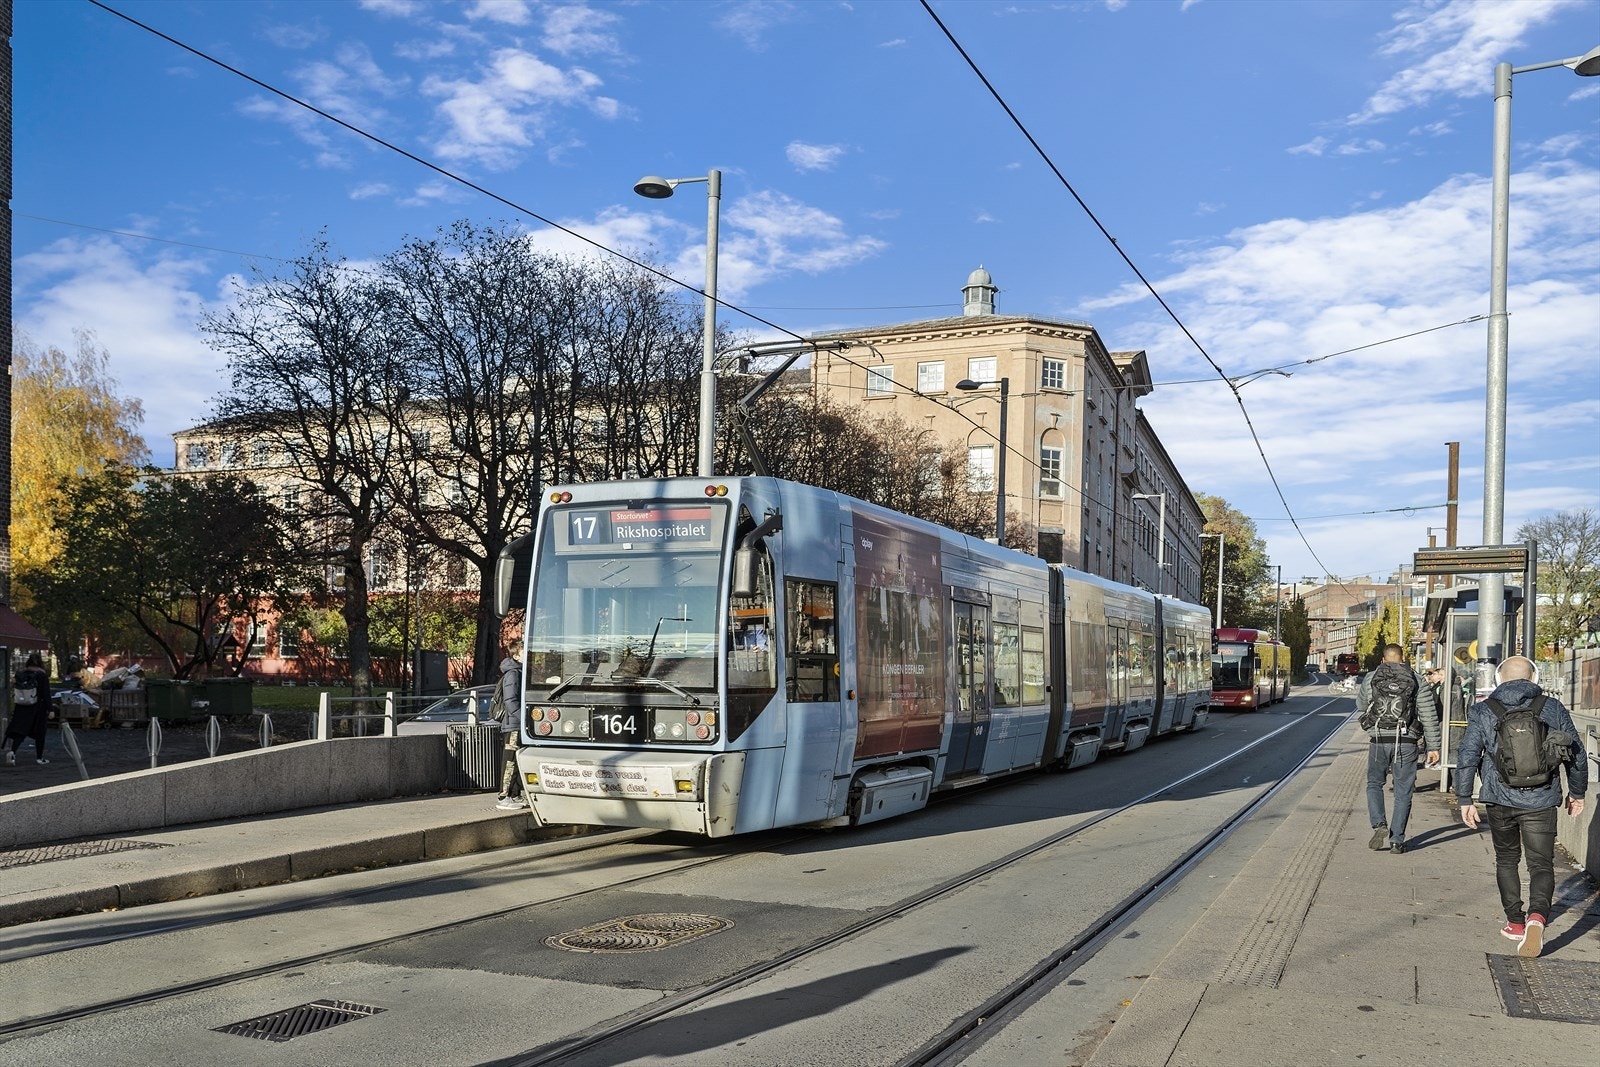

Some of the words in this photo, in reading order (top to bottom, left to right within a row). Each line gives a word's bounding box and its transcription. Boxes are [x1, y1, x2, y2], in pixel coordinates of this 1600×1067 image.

[616, 512, 649, 520] Stortorvet
[573, 517, 597, 539] 17
[617, 524, 706, 540] Rikshospitalet
[882, 664, 904, 675] KONGEN
[904, 664, 925, 675] BEFALER
[601, 714, 637, 735] 164
[542, 765, 580, 777] Trikken
[582, 769, 593, 778] er
[545, 779, 566, 789] ikke
[627, 783, 648, 792] den
